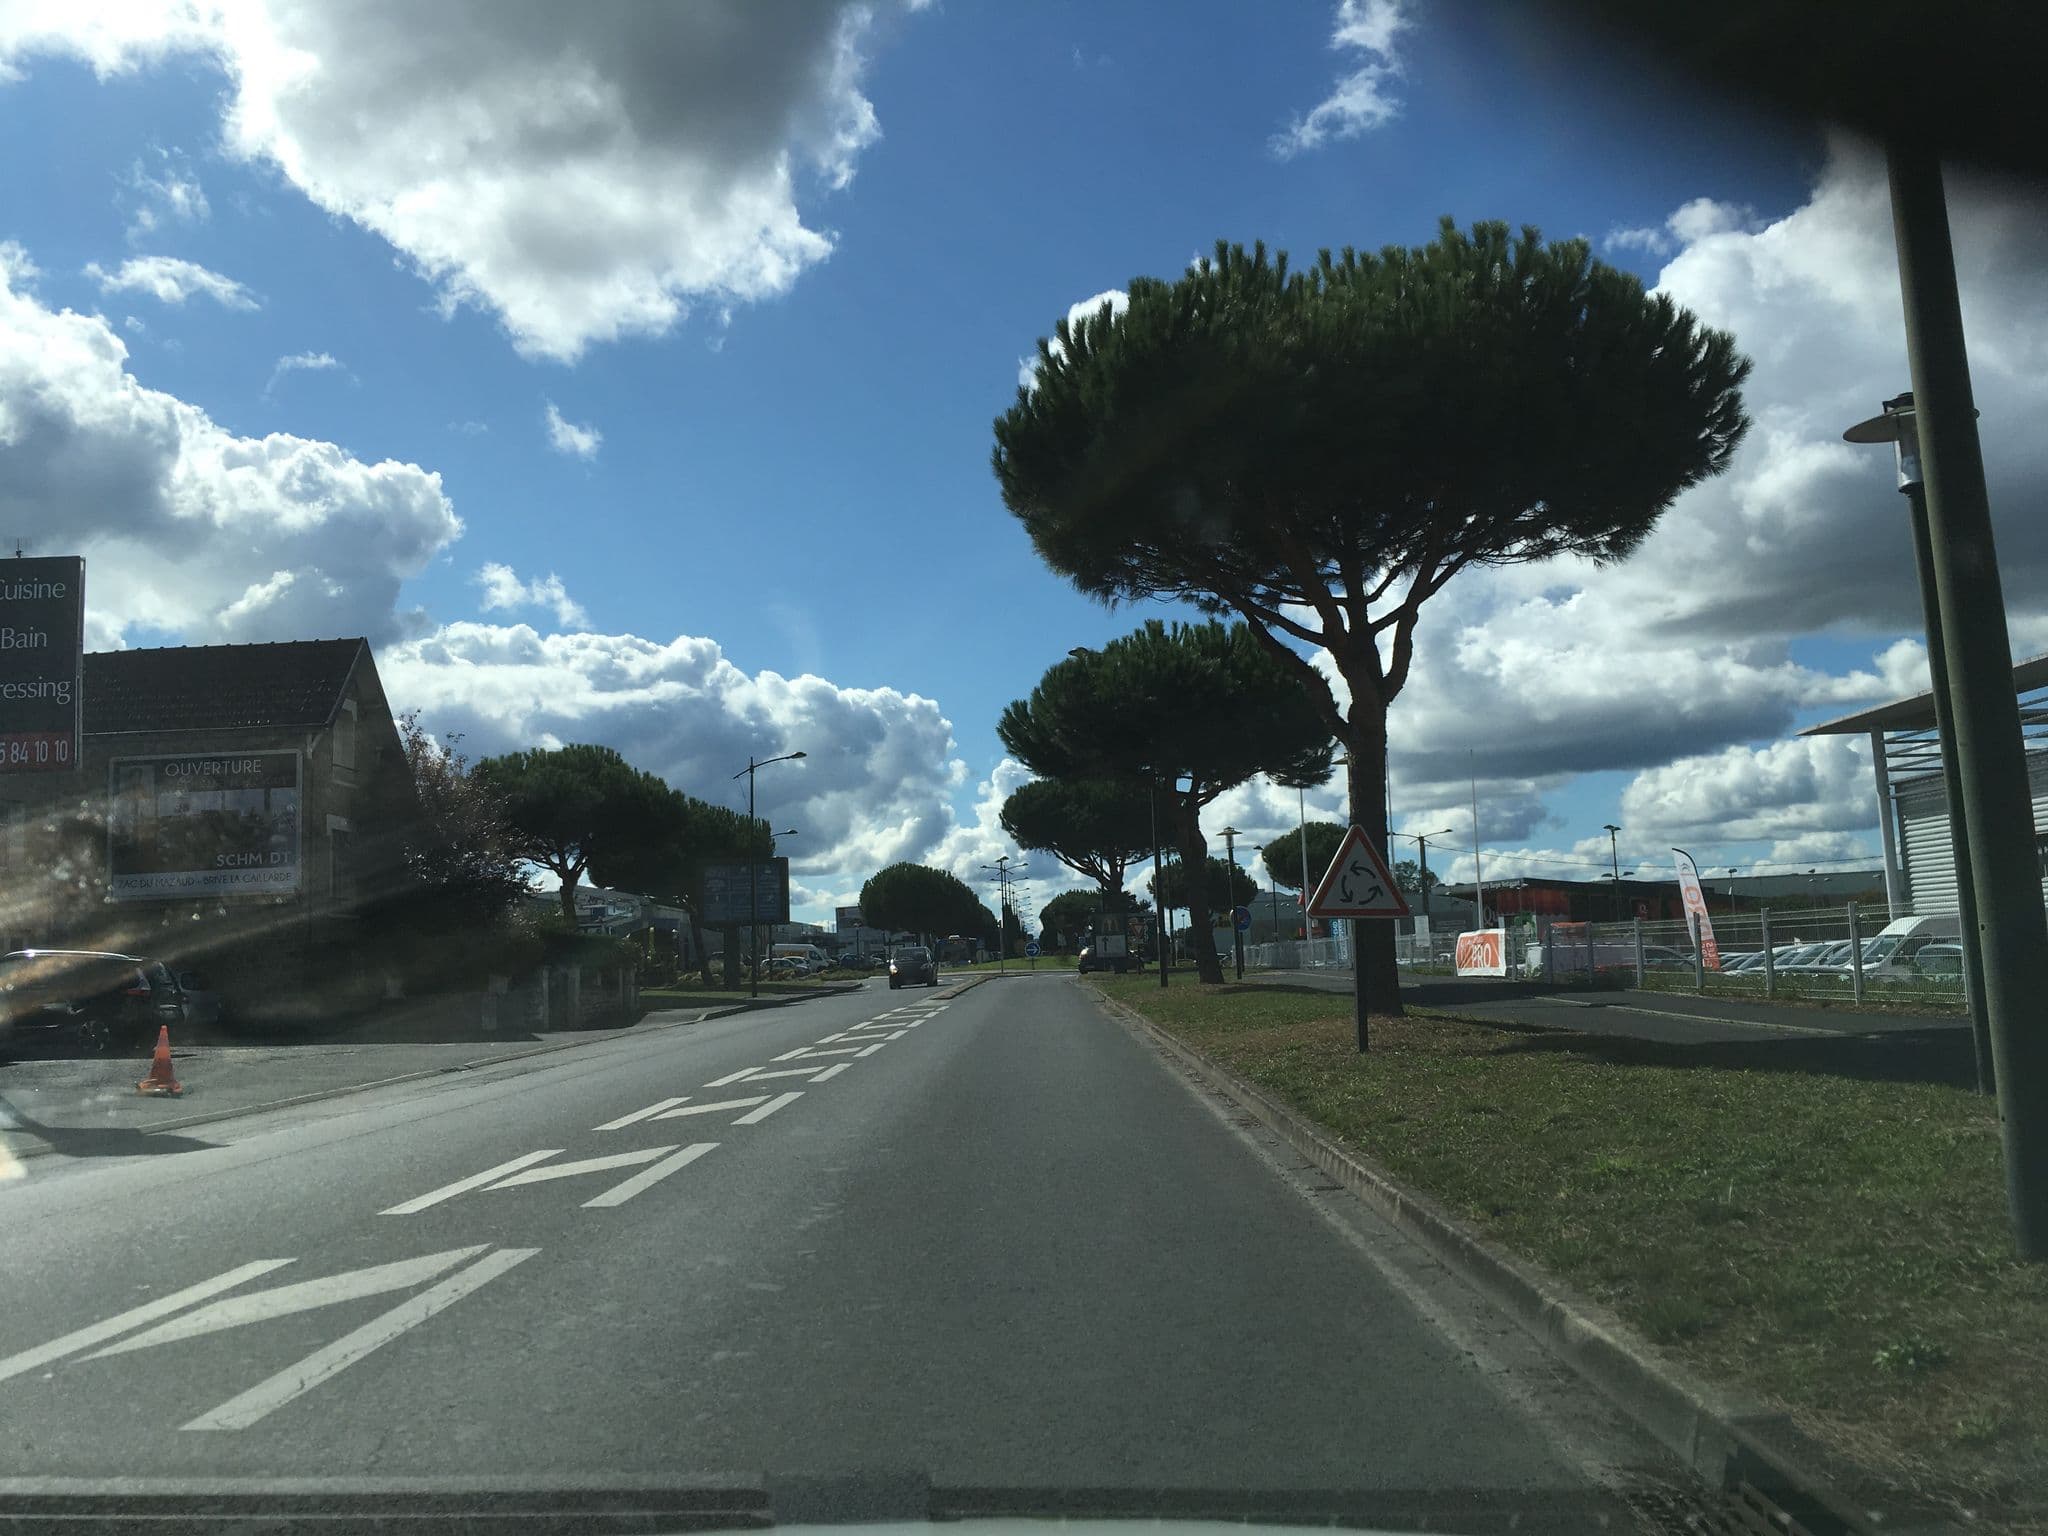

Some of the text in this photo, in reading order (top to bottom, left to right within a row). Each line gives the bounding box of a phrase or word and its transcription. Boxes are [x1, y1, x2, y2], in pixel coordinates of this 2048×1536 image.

[1, 626, 48, 649] Bain
[10, 741, 29, 764] 84
[35, 740, 49, 763] 10
[55, 739, 69, 762] 10
[165, 759, 262, 777] OUVERTURE
[216, 852, 290, 867] SCHMDT
